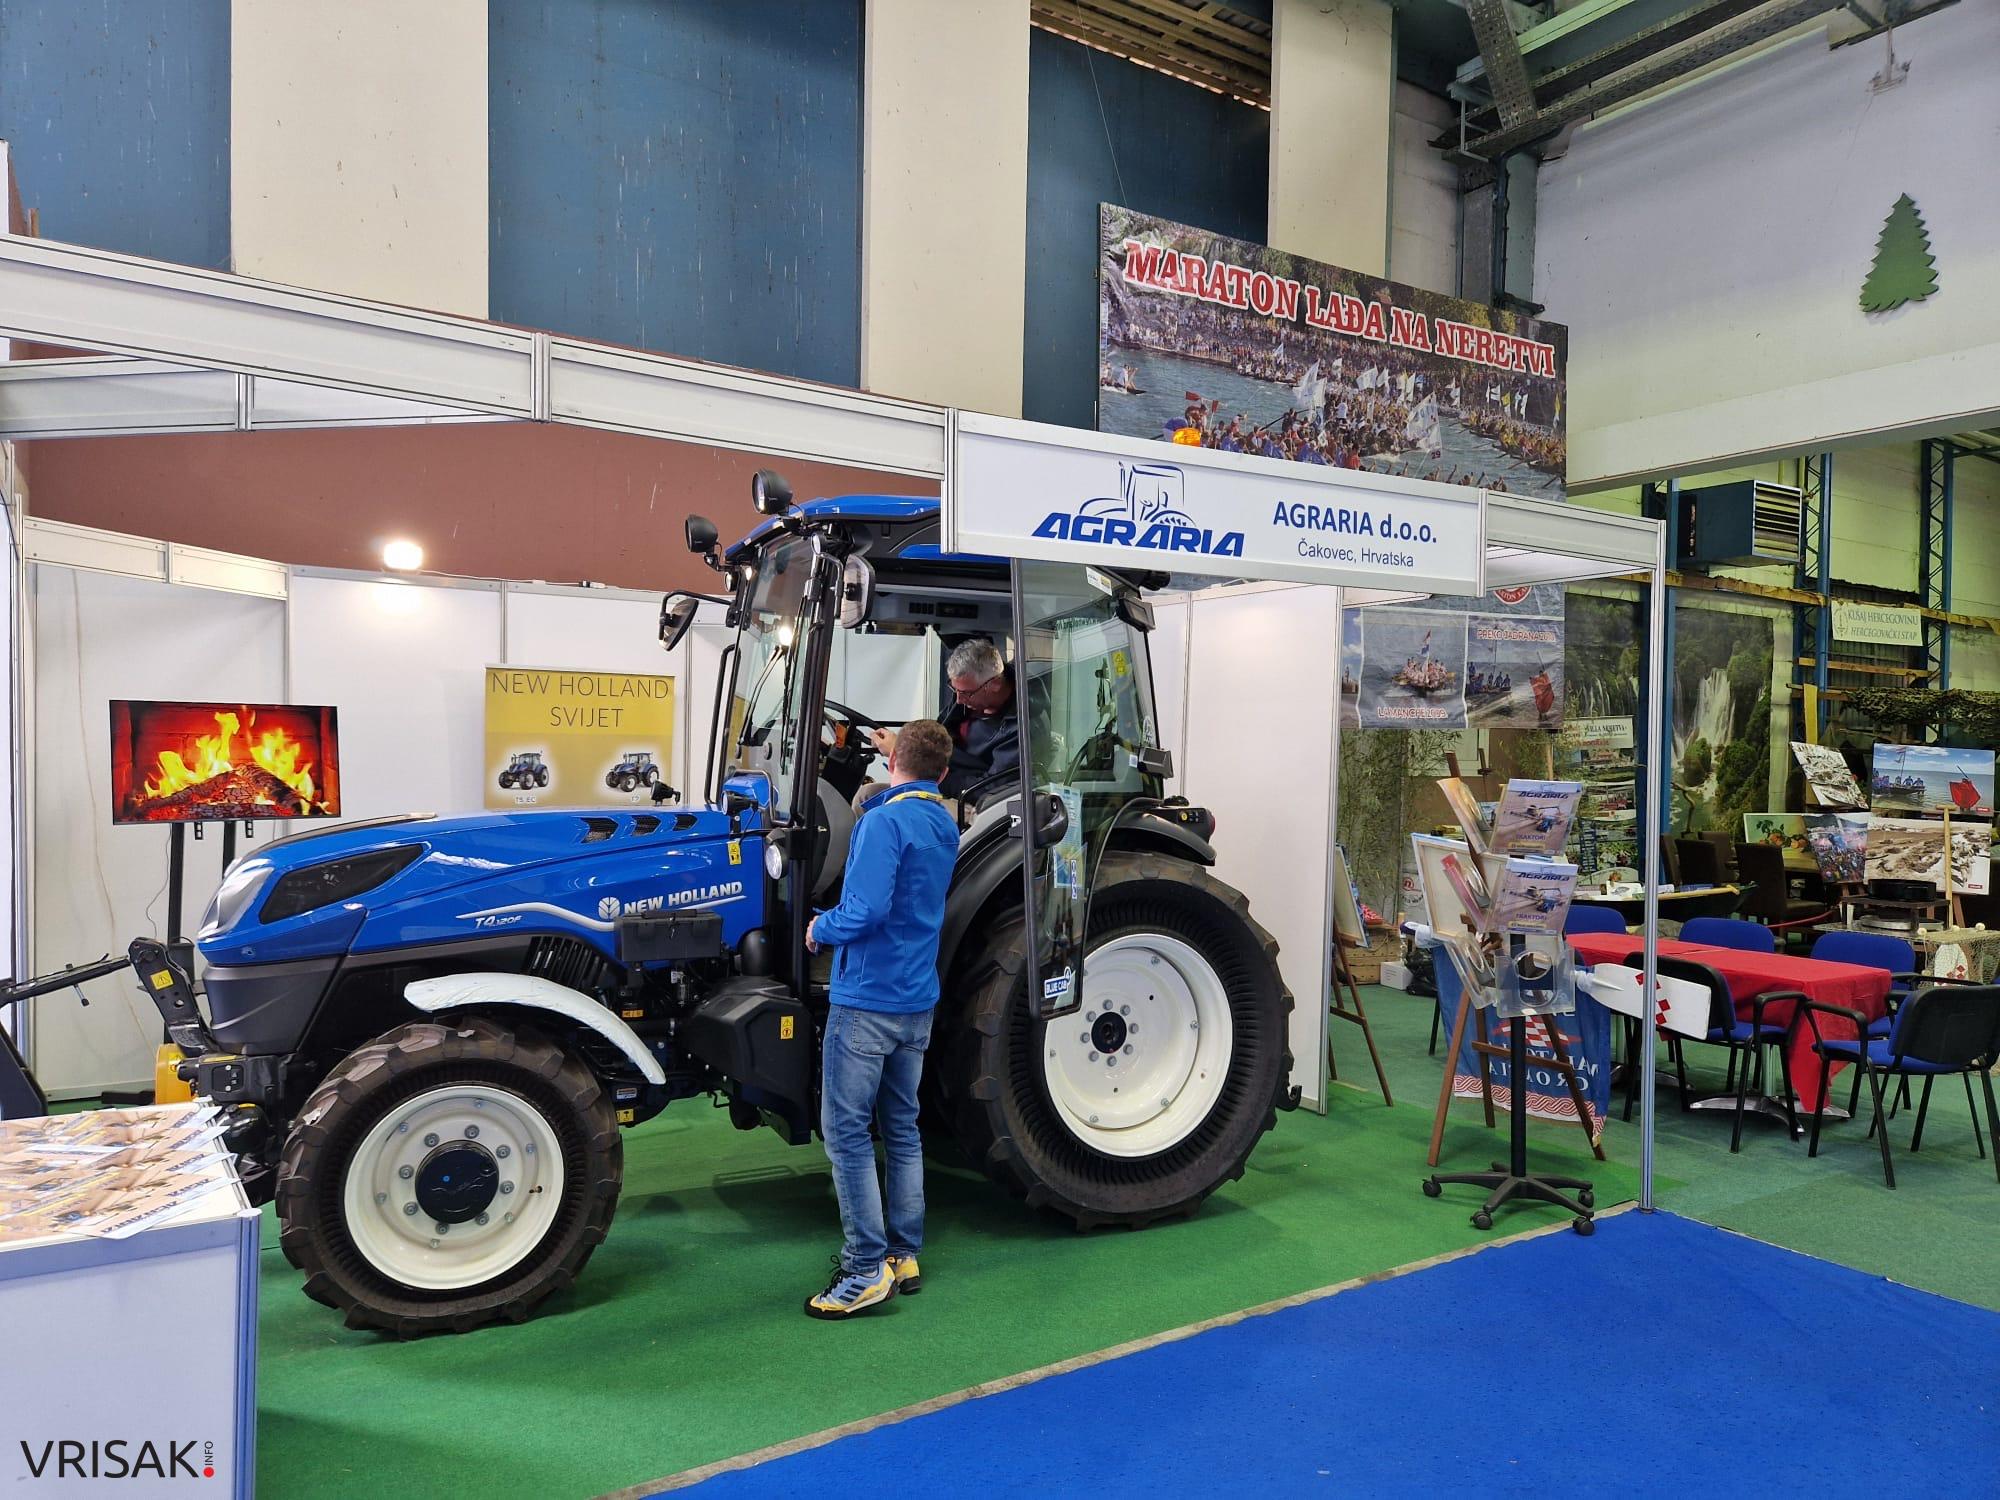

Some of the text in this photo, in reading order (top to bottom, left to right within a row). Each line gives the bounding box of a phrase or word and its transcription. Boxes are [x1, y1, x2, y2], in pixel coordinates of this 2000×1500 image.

[1124, 239, 1556, 378] MARATON LAĐA NA NERETVI
[1031, 512, 1245, 557] AGRARIA
[1273, 501, 1437, 543] AGRARIA d.o.o.
[1298, 539, 1414, 568] Čakovec, Hrvatska
[492, 673, 669, 699] NEW HOLLAND
[550, 706, 624, 728] SVIJET
[624, 881, 743, 912] NEW HOLLAND
